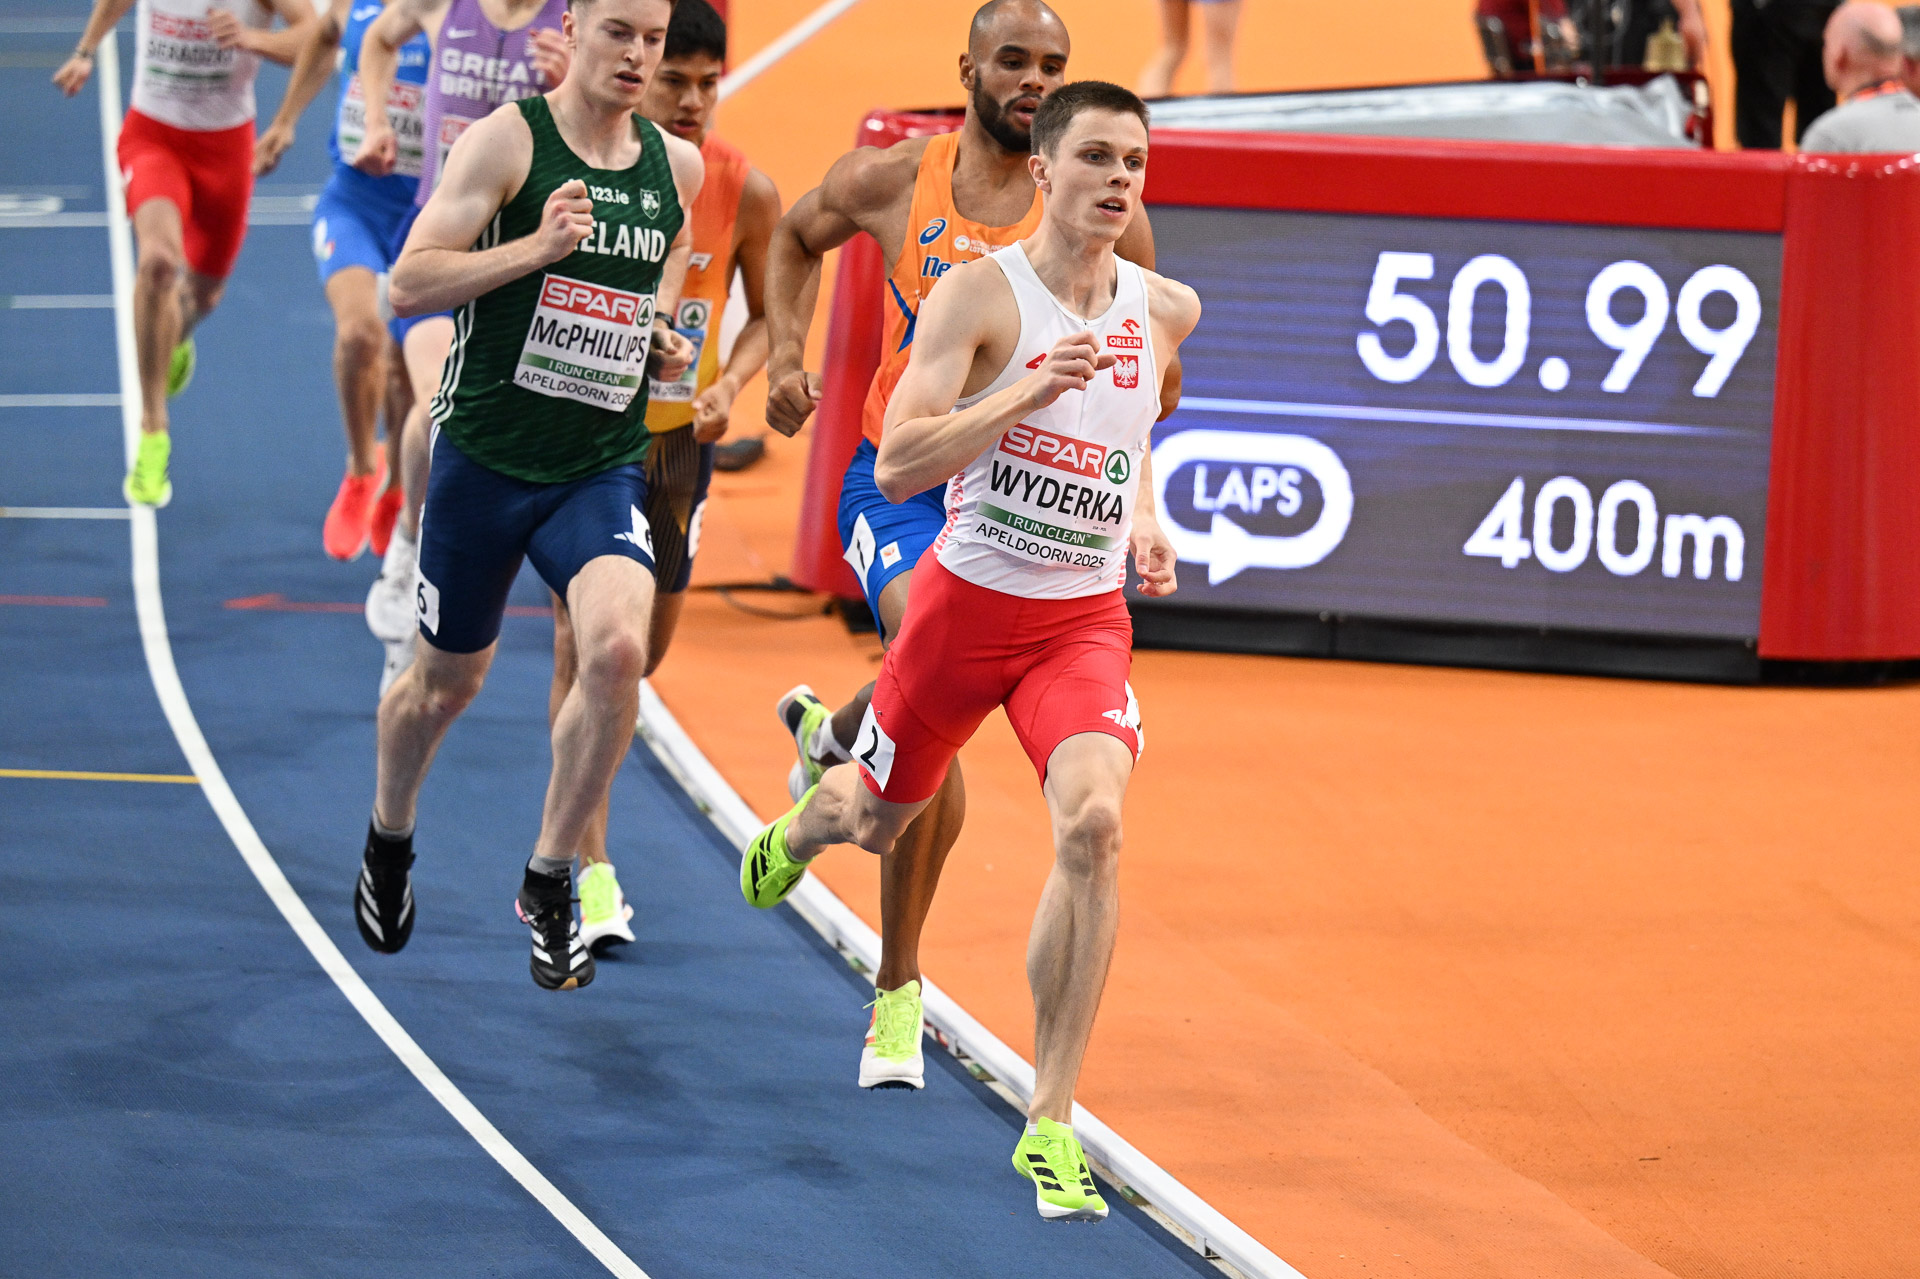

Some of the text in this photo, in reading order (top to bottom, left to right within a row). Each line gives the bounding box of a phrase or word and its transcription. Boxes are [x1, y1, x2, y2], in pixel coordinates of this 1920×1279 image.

[590, 185, 629, 205] 123.ie
[545, 283, 637, 322] SPAR
[1356, 250, 1762, 398] 50.99
[530, 316, 647, 364] McPHILLIPS
[1108, 337, 1141, 347] ORLEN
[519, 371, 634, 406] APELDOORN 202
[554, 361, 582, 378] RUN
[1004, 427, 1103, 474] SPAR
[990, 460, 1123, 525] WYDERKA
[1192, 464, 1303, 516] LAPS
[975, 523, 1106, 568] APELDOORN 2025
[1007, 514, 1011, 524] I
[1013, 516, 1044, 536] RUN
[1463, 476, 1744, 582] 400m
[860, 725, 879, 772] 2
